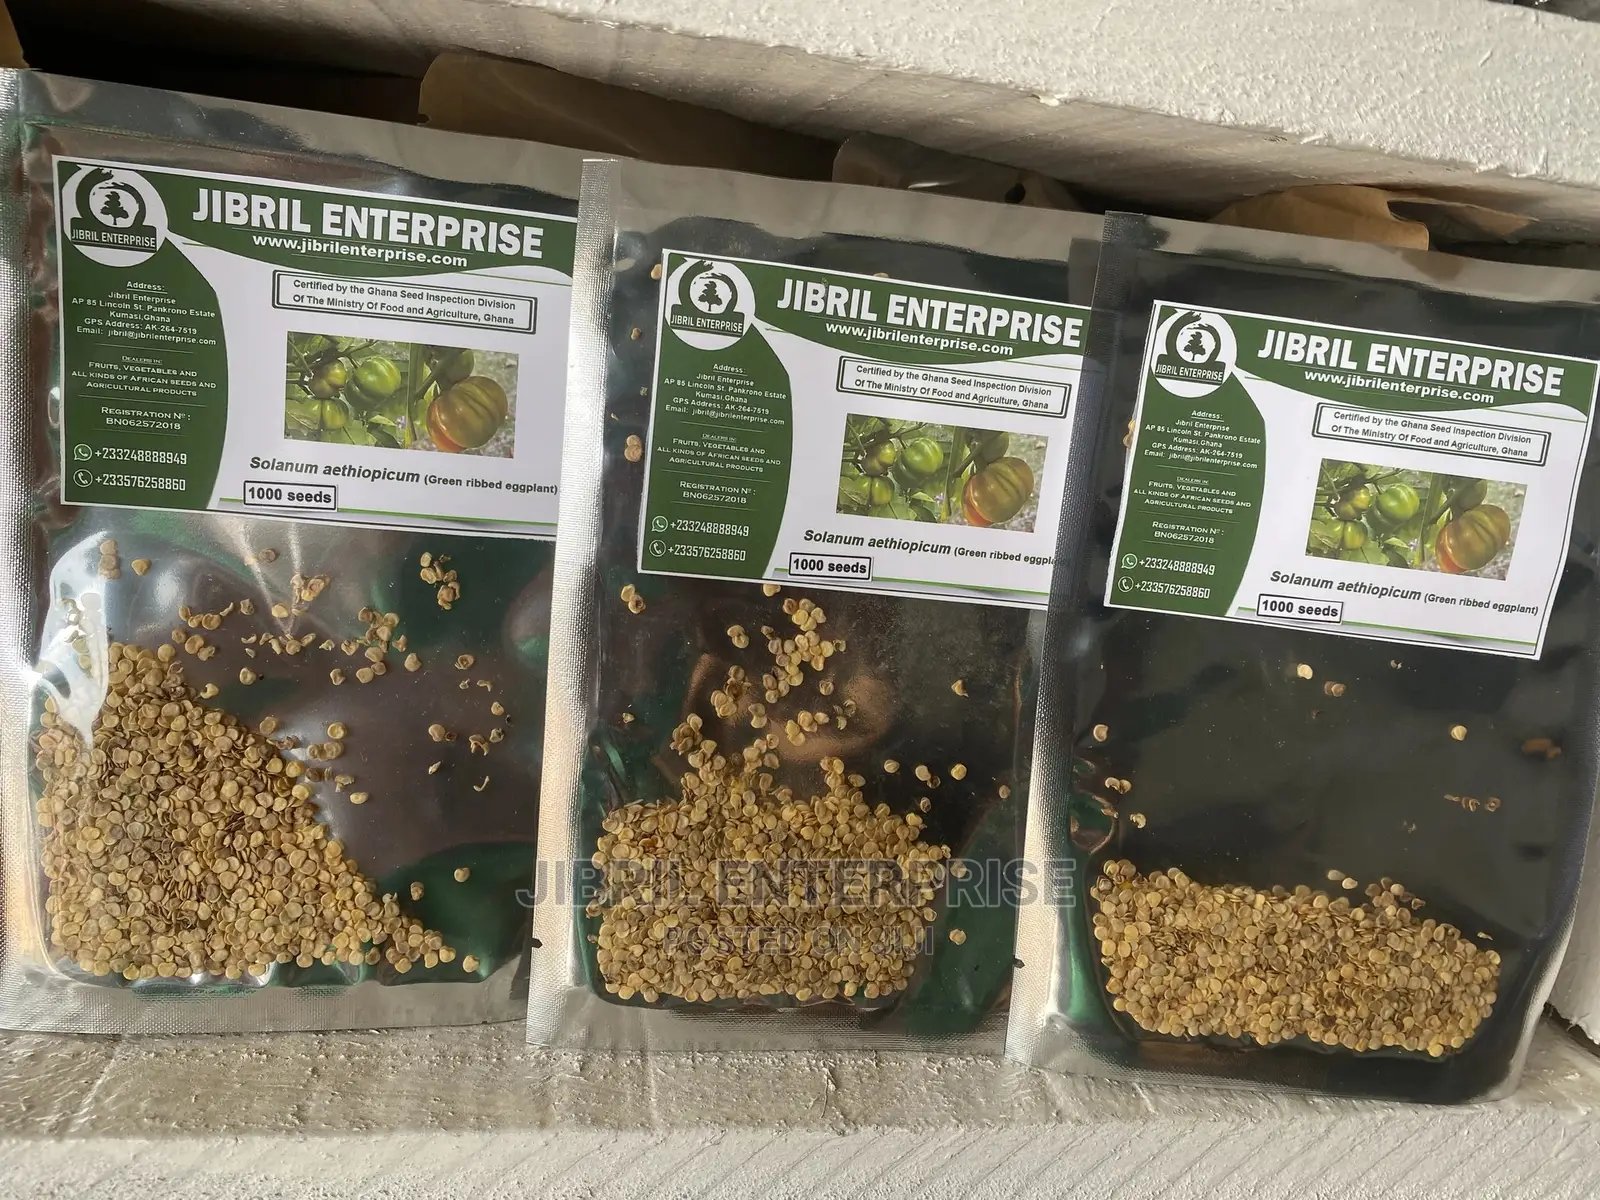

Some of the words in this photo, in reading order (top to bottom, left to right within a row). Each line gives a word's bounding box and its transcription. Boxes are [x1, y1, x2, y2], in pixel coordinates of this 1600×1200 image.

[192, 187, 311, 233] JIBRIL
[322, 202, 543, 258] ENTERPRISE
[69, 228, 99, 241] JIBRIL
[101, 231, 157, 247] ENTERPRISE
[252, 235, 468, 268] www.jibrilenterprise.com
[126, 280, 164, 290] Address:
[293, 278, 334, 291] Certified
[335, 283, 347, 294] by
[349, 284, 364, 294] the
[366, 286, 397, 297] Ghana
[399, 289, 423, 300] Seed
[425, 291, 475, 305] Inspection
[477, 297, 515, 310] Division
[107, 291, 130, 299] Jibril
[132, 293, 175, 304] Enterprise
[99, 299, 130, 309] Lincoln
[146, 304, 187, 315] Pankrono
[189, 308, 215, 317] Estate
[292, 293, 304, 303] Of
[306, 294, 324, 305] The
[326, 296, 364, 309] Ministry
[366, 301, 378, 310] Of
[379, 302, 404, 313] Food
[406, 306, 424, 314] and
[425, 307, 481, 322] Agriculture,
[483, 312, 514, 324] Ghana
[776, 278, 877, 321] JIBRIL
[886, 293, 1083, 347] ENTERPRISE
[84, 317, 103, 325] GPS
[104, 319, 142, 329] Address:
[144, 323, 197, 334] AK-264-7519
[670, 314, 694, 326] JIBRIL
[695, 317, 742, 332] ENTERPRISE
[825, 322, 1013, 355] www.jibrilenterprise.com
[1153, 360, 1177, 375] JIBRIL
[1178, 366, 1223, 383] ENTERPRISE
[1257, 328, 1357, 370] JIBRIL
[1366, 342, 1564, 396] ENTERPRISE
[695, 372, 715, 381] Jibril
[716, 375, 754, 386] Enterprise
[856, 361, 893, 376] Certified
[892, 369, 904, 380] by
[905, 371, 919, 380] the
[921, 372, 949, 384] Ghana
[950, 376, 972, 386] Seed
[973, 378, 1016, 391] Inspection
[1018, 384, 1051, 396] Division
[1304, 370, 1495, 404] www.jibrilenterprise.com
[854, 378, 865, 387] Of
[865, 379, 882, 389] The
[883, 381, 918, 394] Ministry
[919, 386, 930, 395] Of
[931, 387, 953, 398] Food
[954, 392, 971, 400] and
[971, 392, 1019, 407] Agriculture,
[1021, 398, 1048, 409] Ghana
[105, 417, 181, 430] BN062572018
[1174, 418, 1193, 426] Jibril
[1194, 420, 1229, 431] Enterprise
[1333, 410, 1370, 423] Certified
[1371, 415, 1383, 426] by
[1384, 417, 1398, 426] the
[1400, 419, 1428, 430] Ghana
[1429, 423, 1451, 433] Seed
[1452, 426, 1496, 439] Inspection
[1497, 431, 1531, 443] Division
[1330, 424, 1342, 432] Of
[1343, 425, 1359, 435] The
[1361, 428, 1396, 440] Ministry
[1397, 432, 1409, 441] Of
[1409, 434, 1432, 444] Food
[1433, 438, 1450, 447] and
[1450, 439, 1498, 454] Agriculture,
[1500, 446, 1528, 457] Ghana
[94, 446, 187, 464] +233248888949
[94, 473, 185, 490] +233576258860
[249, 456, 318, 474] Solanum
[322, 464, 420, 482] aethiopicum
[423, 474, 462, 486] (Green
[465, 477, 502, 489] ribbed
[504, 482, 558, 495] eggplant)
[248, 486, 282, 500] 1000
[286, 490, 331, 503] seeds
[669, 518, 749, 536] +233248888949
[667, 543, 746, 561] +233576258860
[803, 529, 864, 546] Solanum
[867, 537, 951, 554] aethiopicum
[953, 546, 986, 558] (Green
[989, 550, 1021, 561] ribbed
[791, 552, 824, 571] 1000
[827, 561, 866, 573] seeds
[1138, 556, 1215, 575] +233248888949
[1134, 580, 1210, 598] +233576258860
[1269, 570, 1333, 589] Solanum
[1336, 581, 1421, 600] aethiopicum
[1423, 592, 1456, 605] (Green
[1458, 597, 1491, 608] ribbed
[1491, 602, 1538, 616] eggplant)
[1261, 599, 1293, 613] 1000
[1297, 604, 1338, 617] seeds
